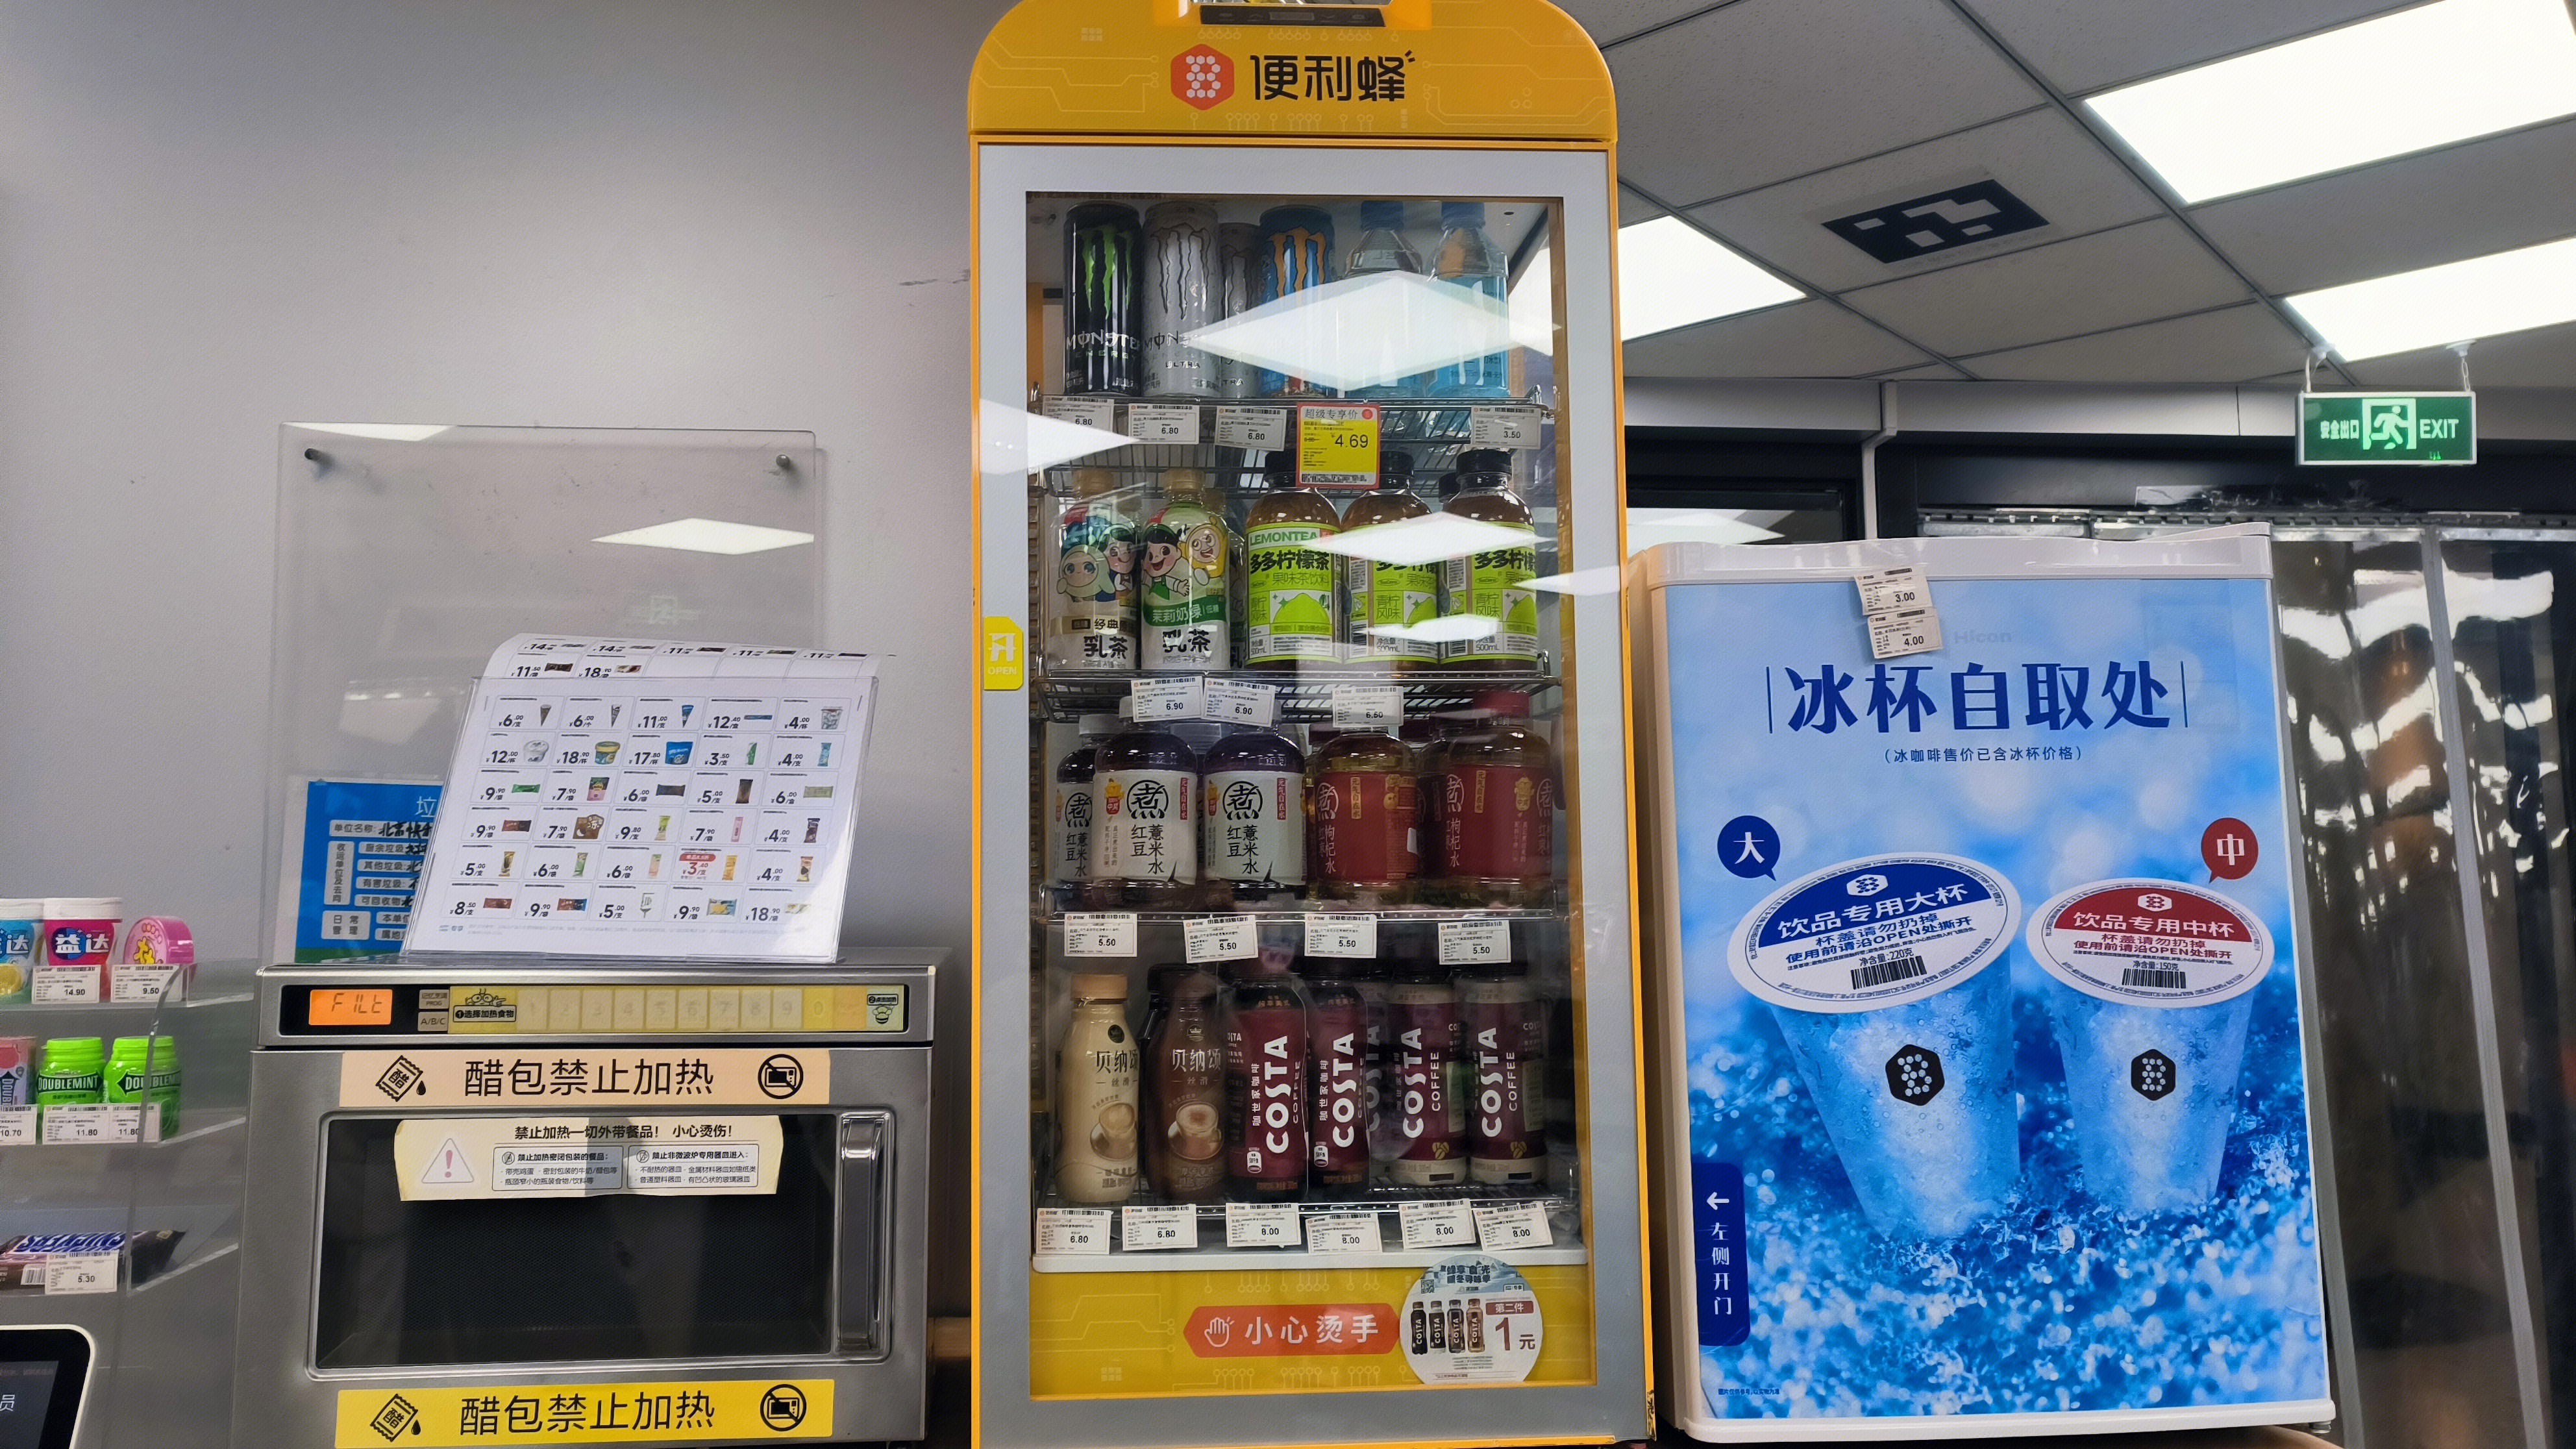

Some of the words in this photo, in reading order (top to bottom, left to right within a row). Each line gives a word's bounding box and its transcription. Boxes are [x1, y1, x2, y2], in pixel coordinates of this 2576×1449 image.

[1250, 51, 1414, 102] 便利蜂
[1165, 360, 1200, 369] ULTRA
[1304, 408, 1358, 419] 超级专享价
[2320, 419, 2359, 440] 安全出口
[2420, 419, 2459, 439] EXIT
[1250, 531, 1318, 546] LEMONTEA
[1250, 550, 1330, 575] 多多柠檬茶
[1272, 572, 1330, 586] 果味茶饮料
[1376, 594, 1400, 607] 青柠
[1475, 593, 1500, 606] 青柠
[1895, 591, 1915, 602] 3.00
[1152, 604, 1202, 624] 茉莉奶绿
[1376, 608, 1401, 620] 风味
[1084, 634, 1128, 660] 乳茶
[1904, 635, 1924, 647] 4.00
[1784, 660, 2172, 734] 冰杯自取处
[1884, 745, 2082, 764] (冰咖啡售价已含冰杯价格)
[1065, 792, 1093, 828] 煮
[1126, 780, 1169, 819] 煮
[1222, 780, 1263, 820] 煮
[334, 823, 376, 834] 单位名称:
[1130, 824, 1148, 858] 红豆
[1147, 824, 1165, 875] 薏米水
[1226, 825, 1243, 858] 红豆
[1242, 824, 1259, 875] 薏米水
[1450, 818, 1461, 867] 枸杞水
[1733, 831, 1765, 865] 大
[2216, 834, 2244, 866] 中
[1776, 884, 1968, 939] 饮品专用大杯
[1815, 913, 1939, 947] 杯盖请勿扔掉
[2073, 911, 2235, 937] 饮品专用中杯
[55, 934, 110, 954] 益达
[1098, 938, 1116, 947] 5.50
[1219, 942, 1237, 950] 5.50
[1339, 939, 1356, 948] 5.50
[1472, 946, 1491, 954] 5.50
[1786, 916, 1972, 963] 使用前请沿OPEN处撕开
[2074, 940, 2233, 959] 使用前请沿OPEN处撕开
[2101, 934, 2207, 948] 杯盖请勿扔掉
[1172, 1048, 1222, 1072] 贝纳颂
[38, 1075, 100, 1091] DOUBLEMINT
[388, 1068, 410, 1089] 醋
[464, 1058, 713, 1097] 醋包禁止加热
[1400, 1028, 1427, 1139] COSTA
[1430, 1052, 1441, 1111] COFFEE
[1478, 1027, 1504, 1137] COSTA
[1506, 1052, 1517, 1111] COFFEE
[1251, 1063, 1261, 1126] 咖世家咖啡
[1264, 1035, 1291, 1154] COSTA
[1333, 1033, 1357, 1148] COSTA
[515, 1124, 658, 1140] 禁止加热一切外带餐品!
[673, 1124, 732, 1138] 小心烫伤!
[1436, 1226, 1454, 1235] 8.00
[1513, 1229, 1531, 1238] 8.00
[1710, 1222, 1731, 1315] 左侧开门
[1495, 1303, 1524, 1313] 第二件
[1244, 1314, 1379, 1345] 小心烫手
[1519, 1334, 1535, 1350] 元
[0, 1394, 16, 1411] 员
[385, 1407, 404, 1428] 醋
[460, 1390, 715, 1437] 醋包禁止加热
